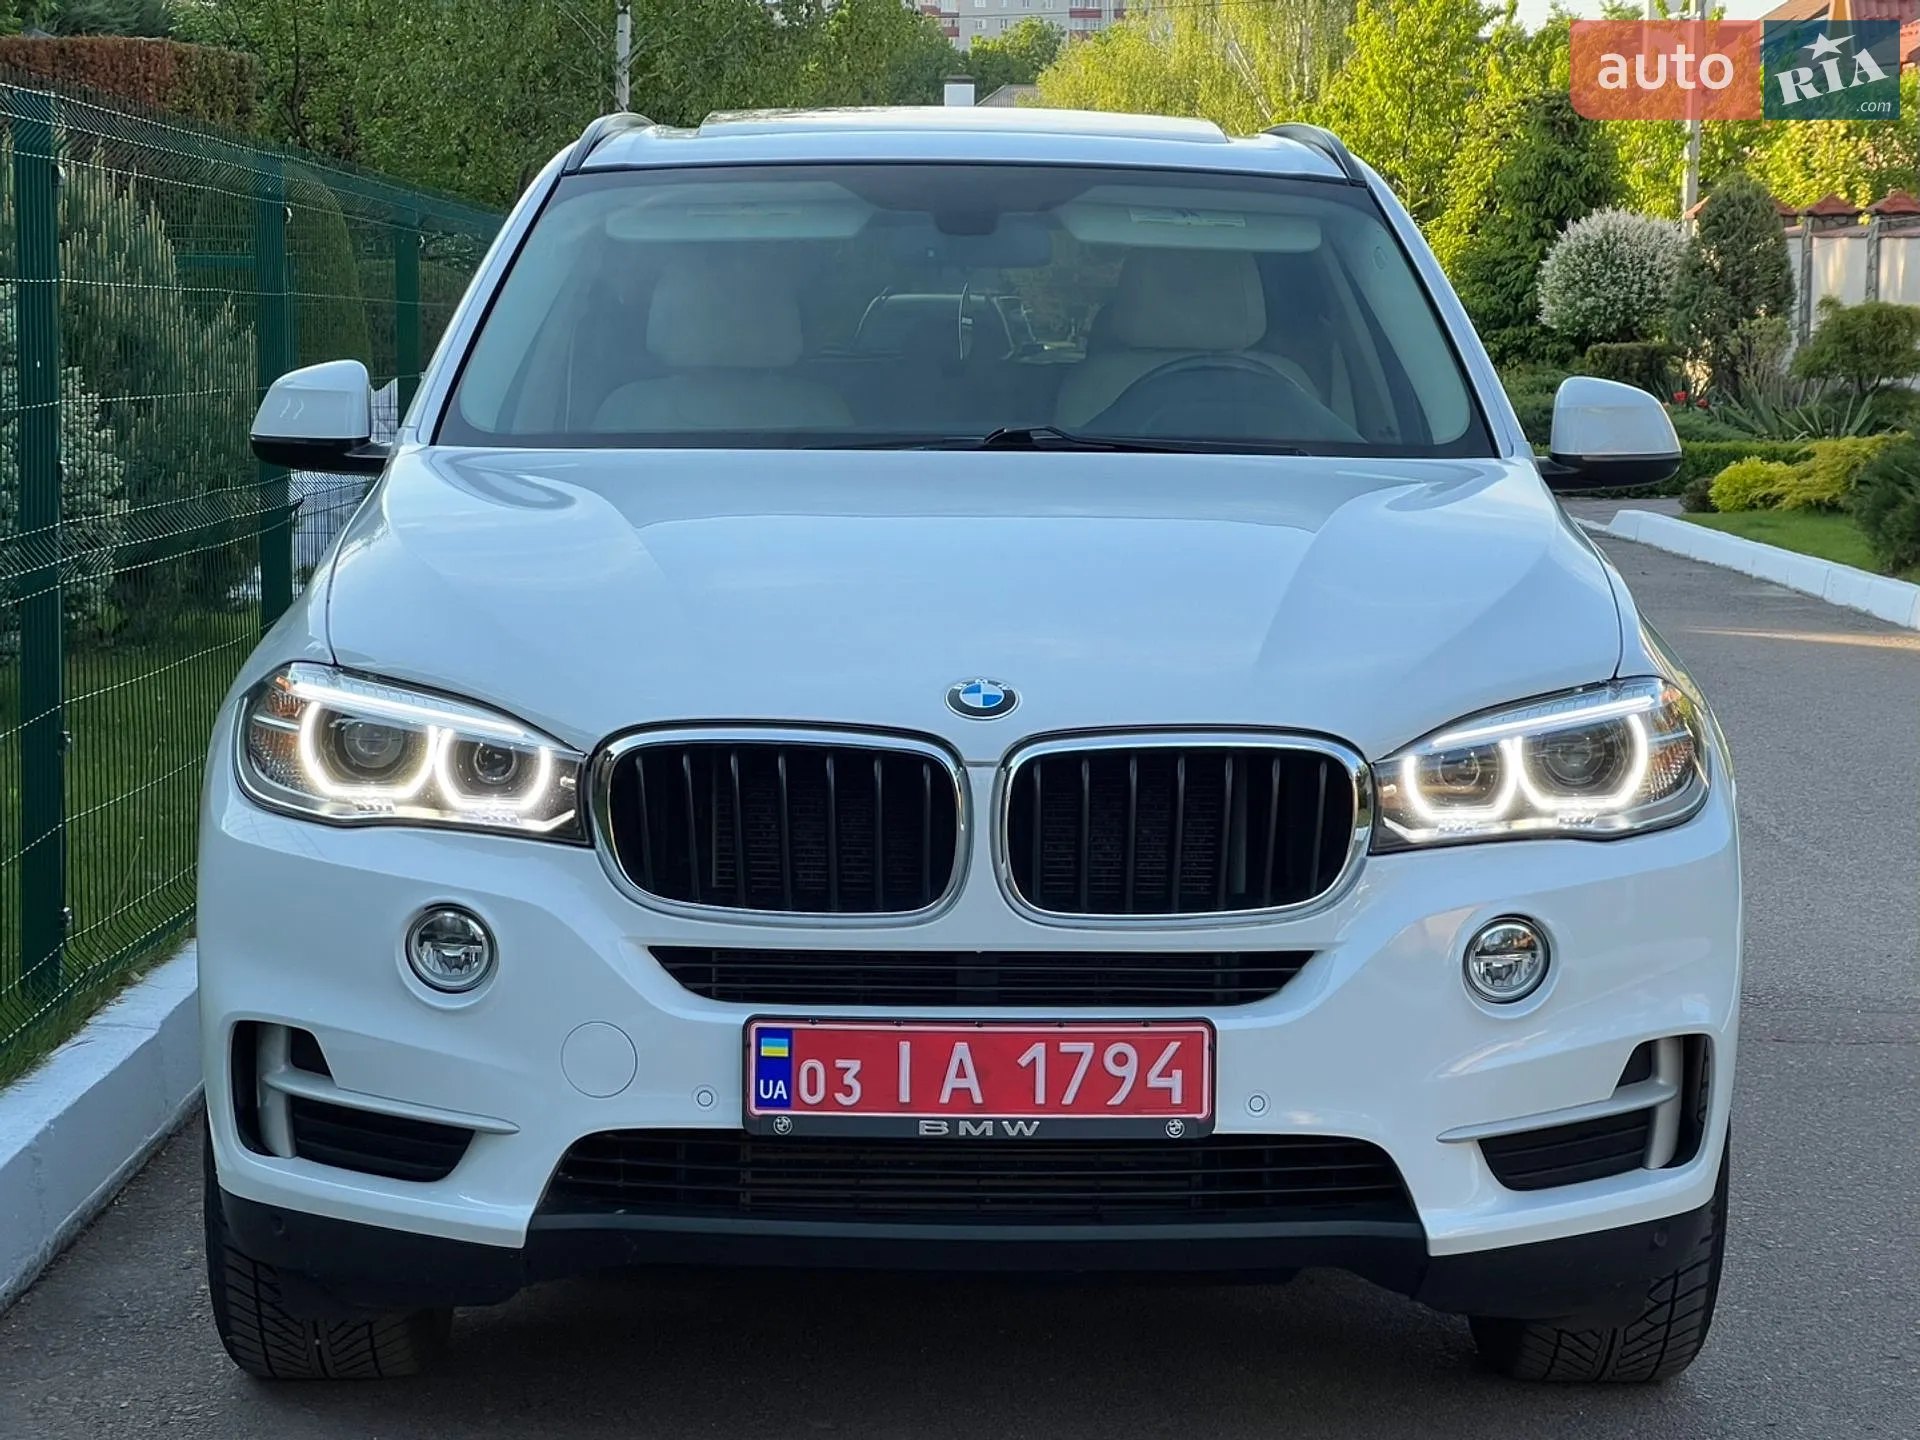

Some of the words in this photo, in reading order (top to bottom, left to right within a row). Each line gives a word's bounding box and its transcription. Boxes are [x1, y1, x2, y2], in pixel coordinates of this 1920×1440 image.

[799, 1058, 862, 1106] 03
[1017, 1041, 1184, 1106] 1794
[759, 1079, 788, 1100] UA
[918, 1119, 1040, 1137] BMW
